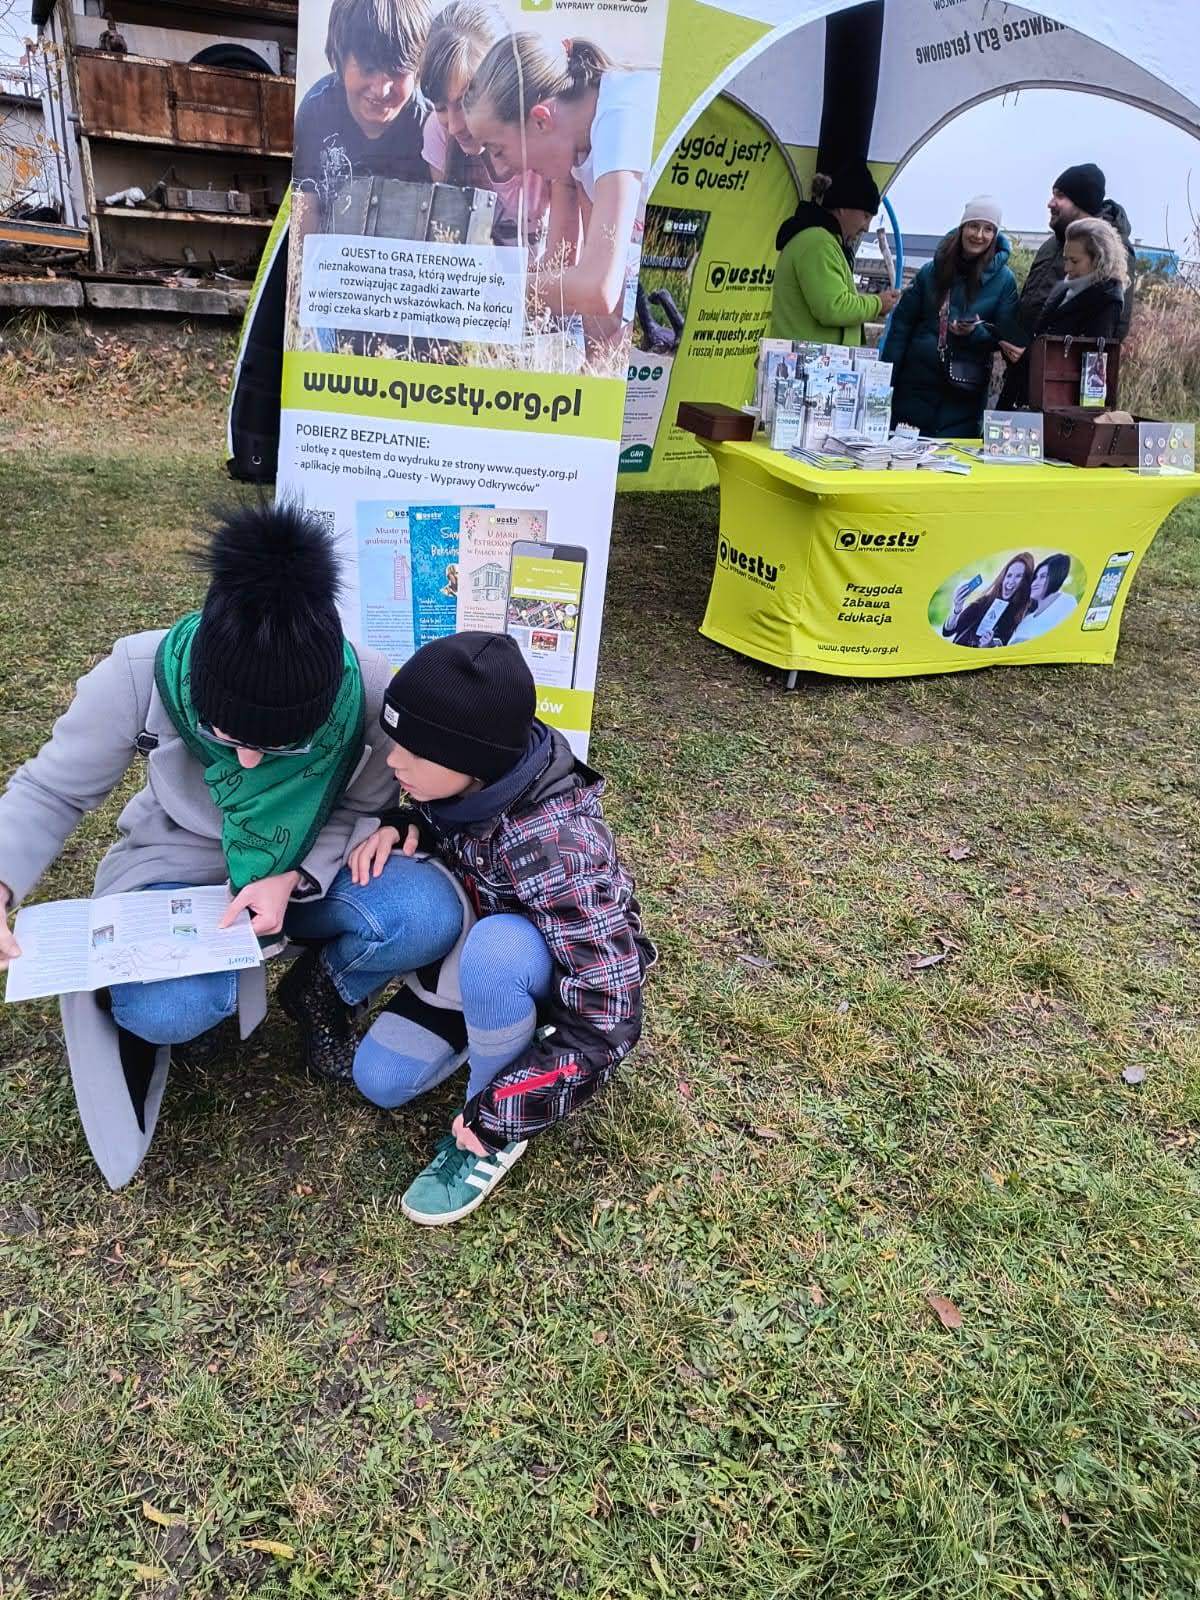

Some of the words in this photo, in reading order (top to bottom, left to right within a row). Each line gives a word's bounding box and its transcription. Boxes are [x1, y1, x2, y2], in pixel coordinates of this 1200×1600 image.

[675, 134, 727, 160] ygód
[725, 140, 772, 166] jest?
[695, 168, 749, 191] Quest!
[341, 247, 376, 259] QUEST
[378, 251, 388, 260] to
[391, 251, 413, 263] GRA
[416, 253, 476, 268] TERENOWA
[318, 260, 386, 275] nieznakowana
[389, 266, 416, 279] trasa,
[419, 268, 445, 282] którą
[447, 272, 487, 285] wędruje
[489, 273, 505, 286] się,
[711, 264, 775, 288] Questy
[340, 277, 398, 292] rozwiązując
[400, 283, 439, 294] zagadki
[441, 286, 480, 297] zawarte
[308, 290, 316, 298] w
[318, 288, 392, 305] wierszowanych
[394, 295, 465, 310] wskazówkach.
[467, 301, 481, 312] Na
[483, 301, 513, 314] końcu
[308, 302, 332, 314] drogi
[334, 304, 361, 315] czeka
[363, 306, 391, 318] skarb
[400, 311, 460, 327] pamiątkową
[463, 315, 511, 330] pieczęcią!
[721, 309, 739, 323] karty
[303, 371, 582, 422] www.questy.org.pl
[296, 424, 347, 440] POBIERZ
[351, 429, 430, 449] BEZPŁATNIE:
[300, 460, 340, 474] aplikację
[342, 465, 381, 479] mobilną
[430, 472, 476, 488] Wyprawy
[301, 443, 329, 457] ulotkę
[331, 447, 337, 455] z
[339, 448, 381, 461] questem
[383, 452, 396, 462] do
[398, 454, 440, 467] wydruku
[442, 459, 453, 468] ze
[455, 460, 485, 473] strony
[487, 463, 578, 482] www.questy.org.pl
[840, 531, 920, 548] Questy
[720, 541, 778, 583] Questy
[846, 583, 903, 597] Przygoda
[842, 597, 890, 609] Zabawa
[837, 612, 892, 625] Edukacja
[817, 643, 899, 655] www.questy.org.pl
